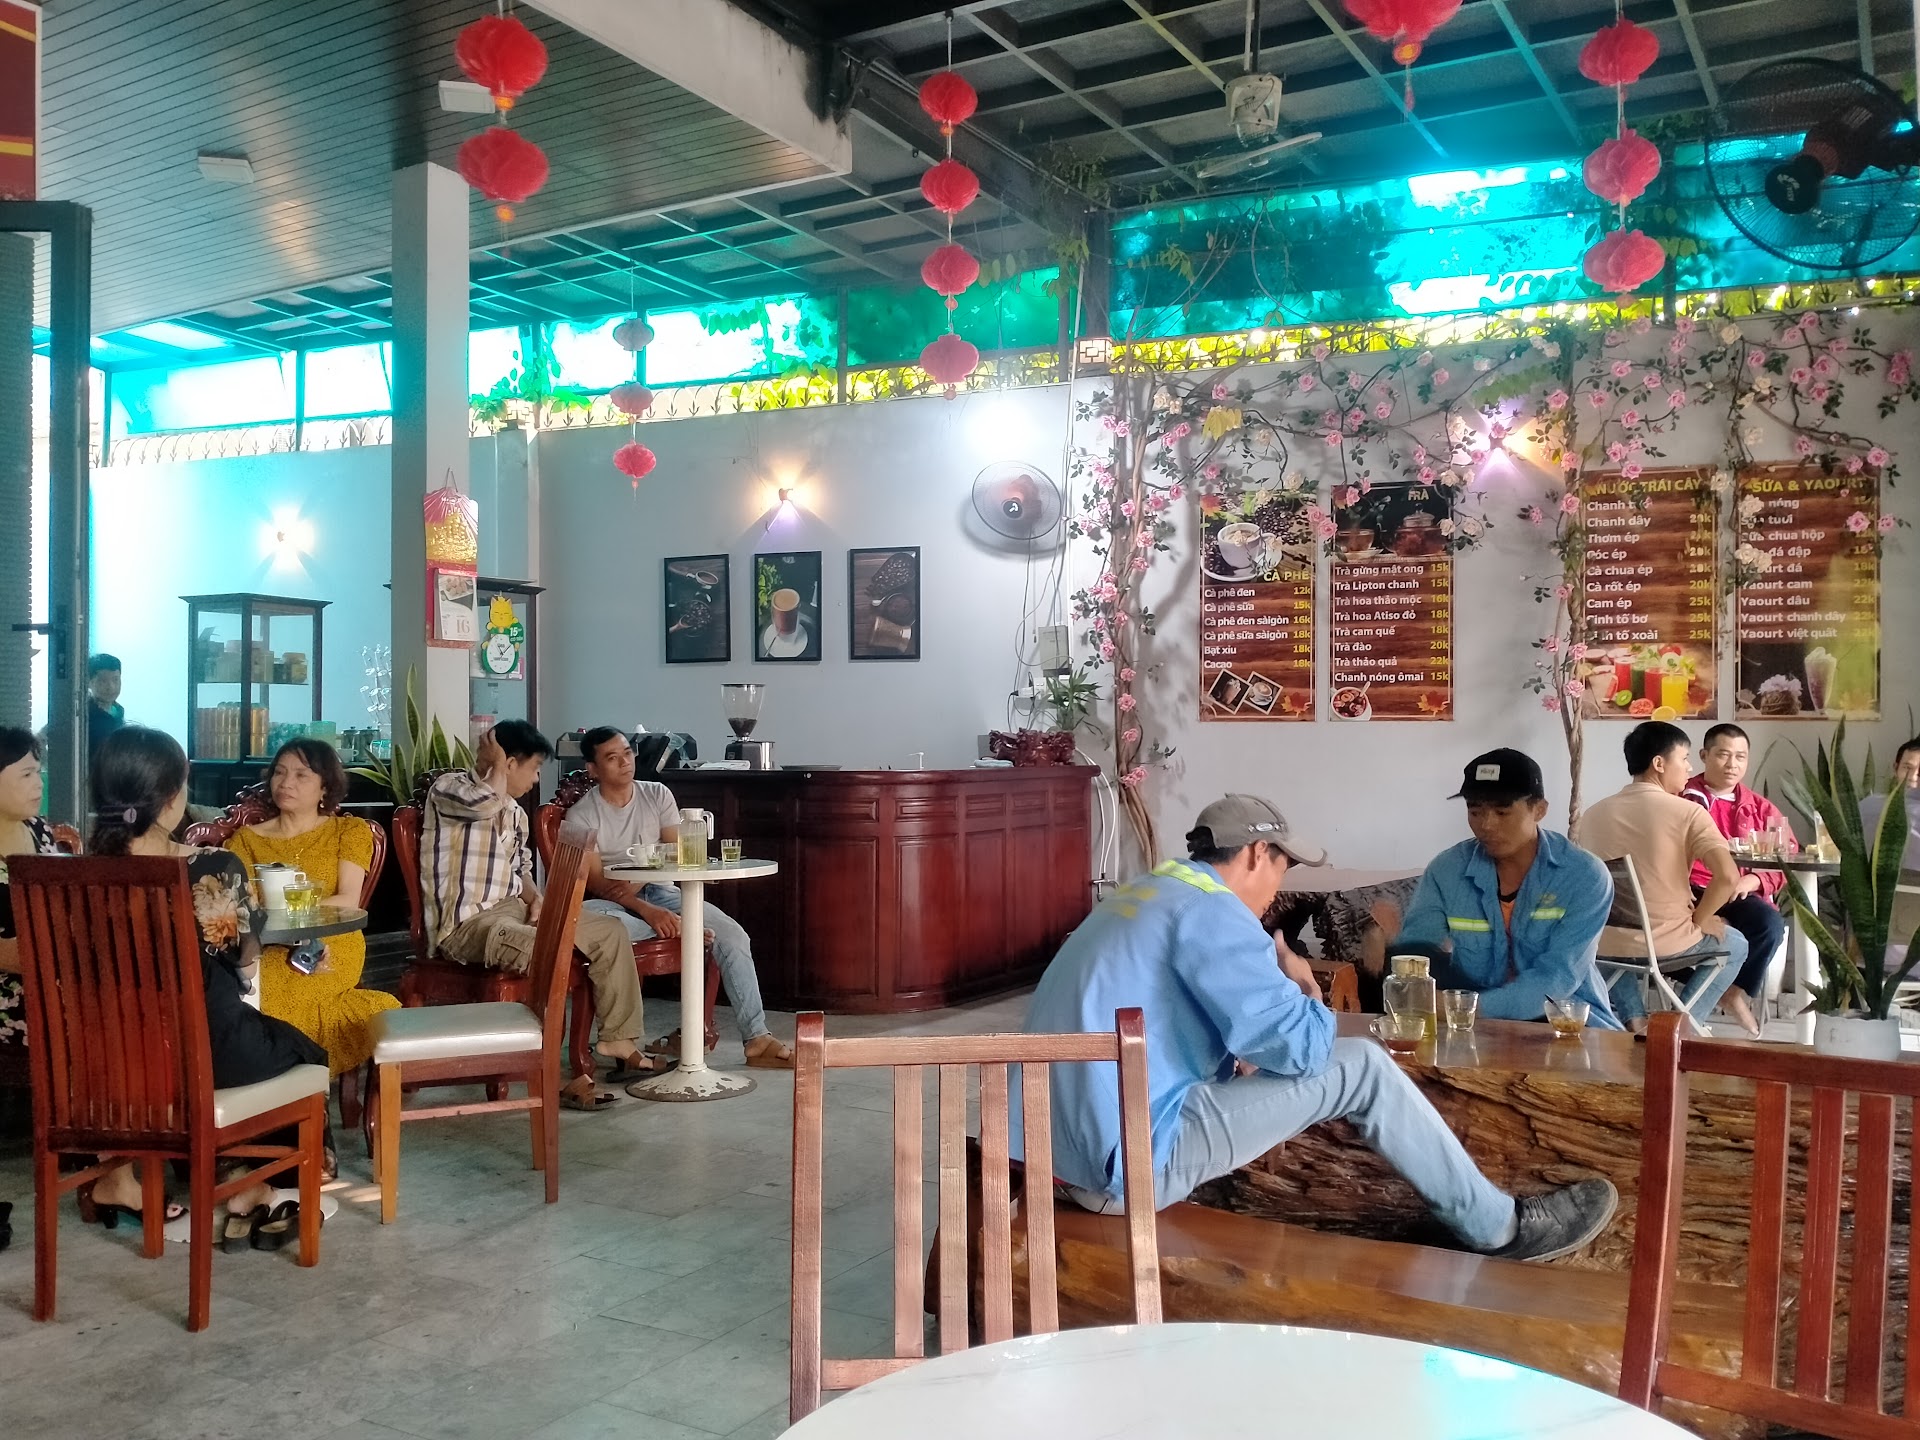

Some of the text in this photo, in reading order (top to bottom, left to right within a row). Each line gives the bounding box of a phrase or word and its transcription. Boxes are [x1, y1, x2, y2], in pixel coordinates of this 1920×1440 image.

[1674, 477, 1701, 490] CÂY
[1752, 479, 1784, 493] SỮA
[1787, 480, 1800, 491] &
[1587, 500, 1625, 511] Chanh
[1587, 516, 1625, 527] Chanh
[1628, 515, 1651, 527] dây
[1624, 532, 1640, 543] ép
[1689, 530, 1712, 540] 2k
[1768, 530, 1798, 541] chua
[1801, 529, 1825, 541] hộp
[1611, 548, 1627, 561] ép
[1263, 567, 1310, 581] CÀ PHÊ
[1335, 563, 1449, 577] Trà gừng mật ong 15k
[1587, 566, 1602, 576] Cà
[1605, 565, 1634, 576] chua
[1637, 564, 1653, 576] ép
[1335, 579, 1449, 592] Trà Lipton chanh 15k
[1587, 580, 1711, 592] Cà rốt ép 20k
[1787, 580, 1813, 589] cam
[1204, 586, 1311, 598] Cà phê đen 12k
[1335, 594, 1449, 606] Trà hoa thảo mộc 16k
[1586, 597, 1711, 609] Cam ép 25k
[1740, 596, 1784, 606] Yaourt
[1787, 595, 1810, 606] dâu
[1204, 601, 1311, 613] Cà phê sữa 15k
[1204, 615, 1311, 627] Cà phê đen sàigòn 16k
[1335, 609, 1449, 621] Trà hoa Atiso đỏ 18k
[1632, 613, 1648, 624] bơ
[1689, 613, 1711, 623] 25k
[1740, 613, 1784, 623] Yaourt
[1787, 611, 1822, 622] chanh
[1824, 611, 1846, 623] dây
[456, 619, 470, 633] 16
[1335, 625, 1449, 637] Trà cam quế 18k
[1204, 629, 1311, 641] Cà phê sữa sàigòn 18k
[1632, 629, 1658, 640] xoài
[1689, 630, 1711, 640] 25k
[1740, 629, 1784, 639] Yaourt
[1787, 628, 1809, 640] việt
[1204, 646, 1220, 656] Bạt
[1293, 644, 1311, 653] 18k
[1335, 641, 1449, 651] Trà đào 20k
[1204, 659, 1311, 668] Cacao 18k
[1335, 656, 1449, 668] Trà thảo quả 22k
[1335, 671, 1449, 683] Chanh nóng ômai 15k
